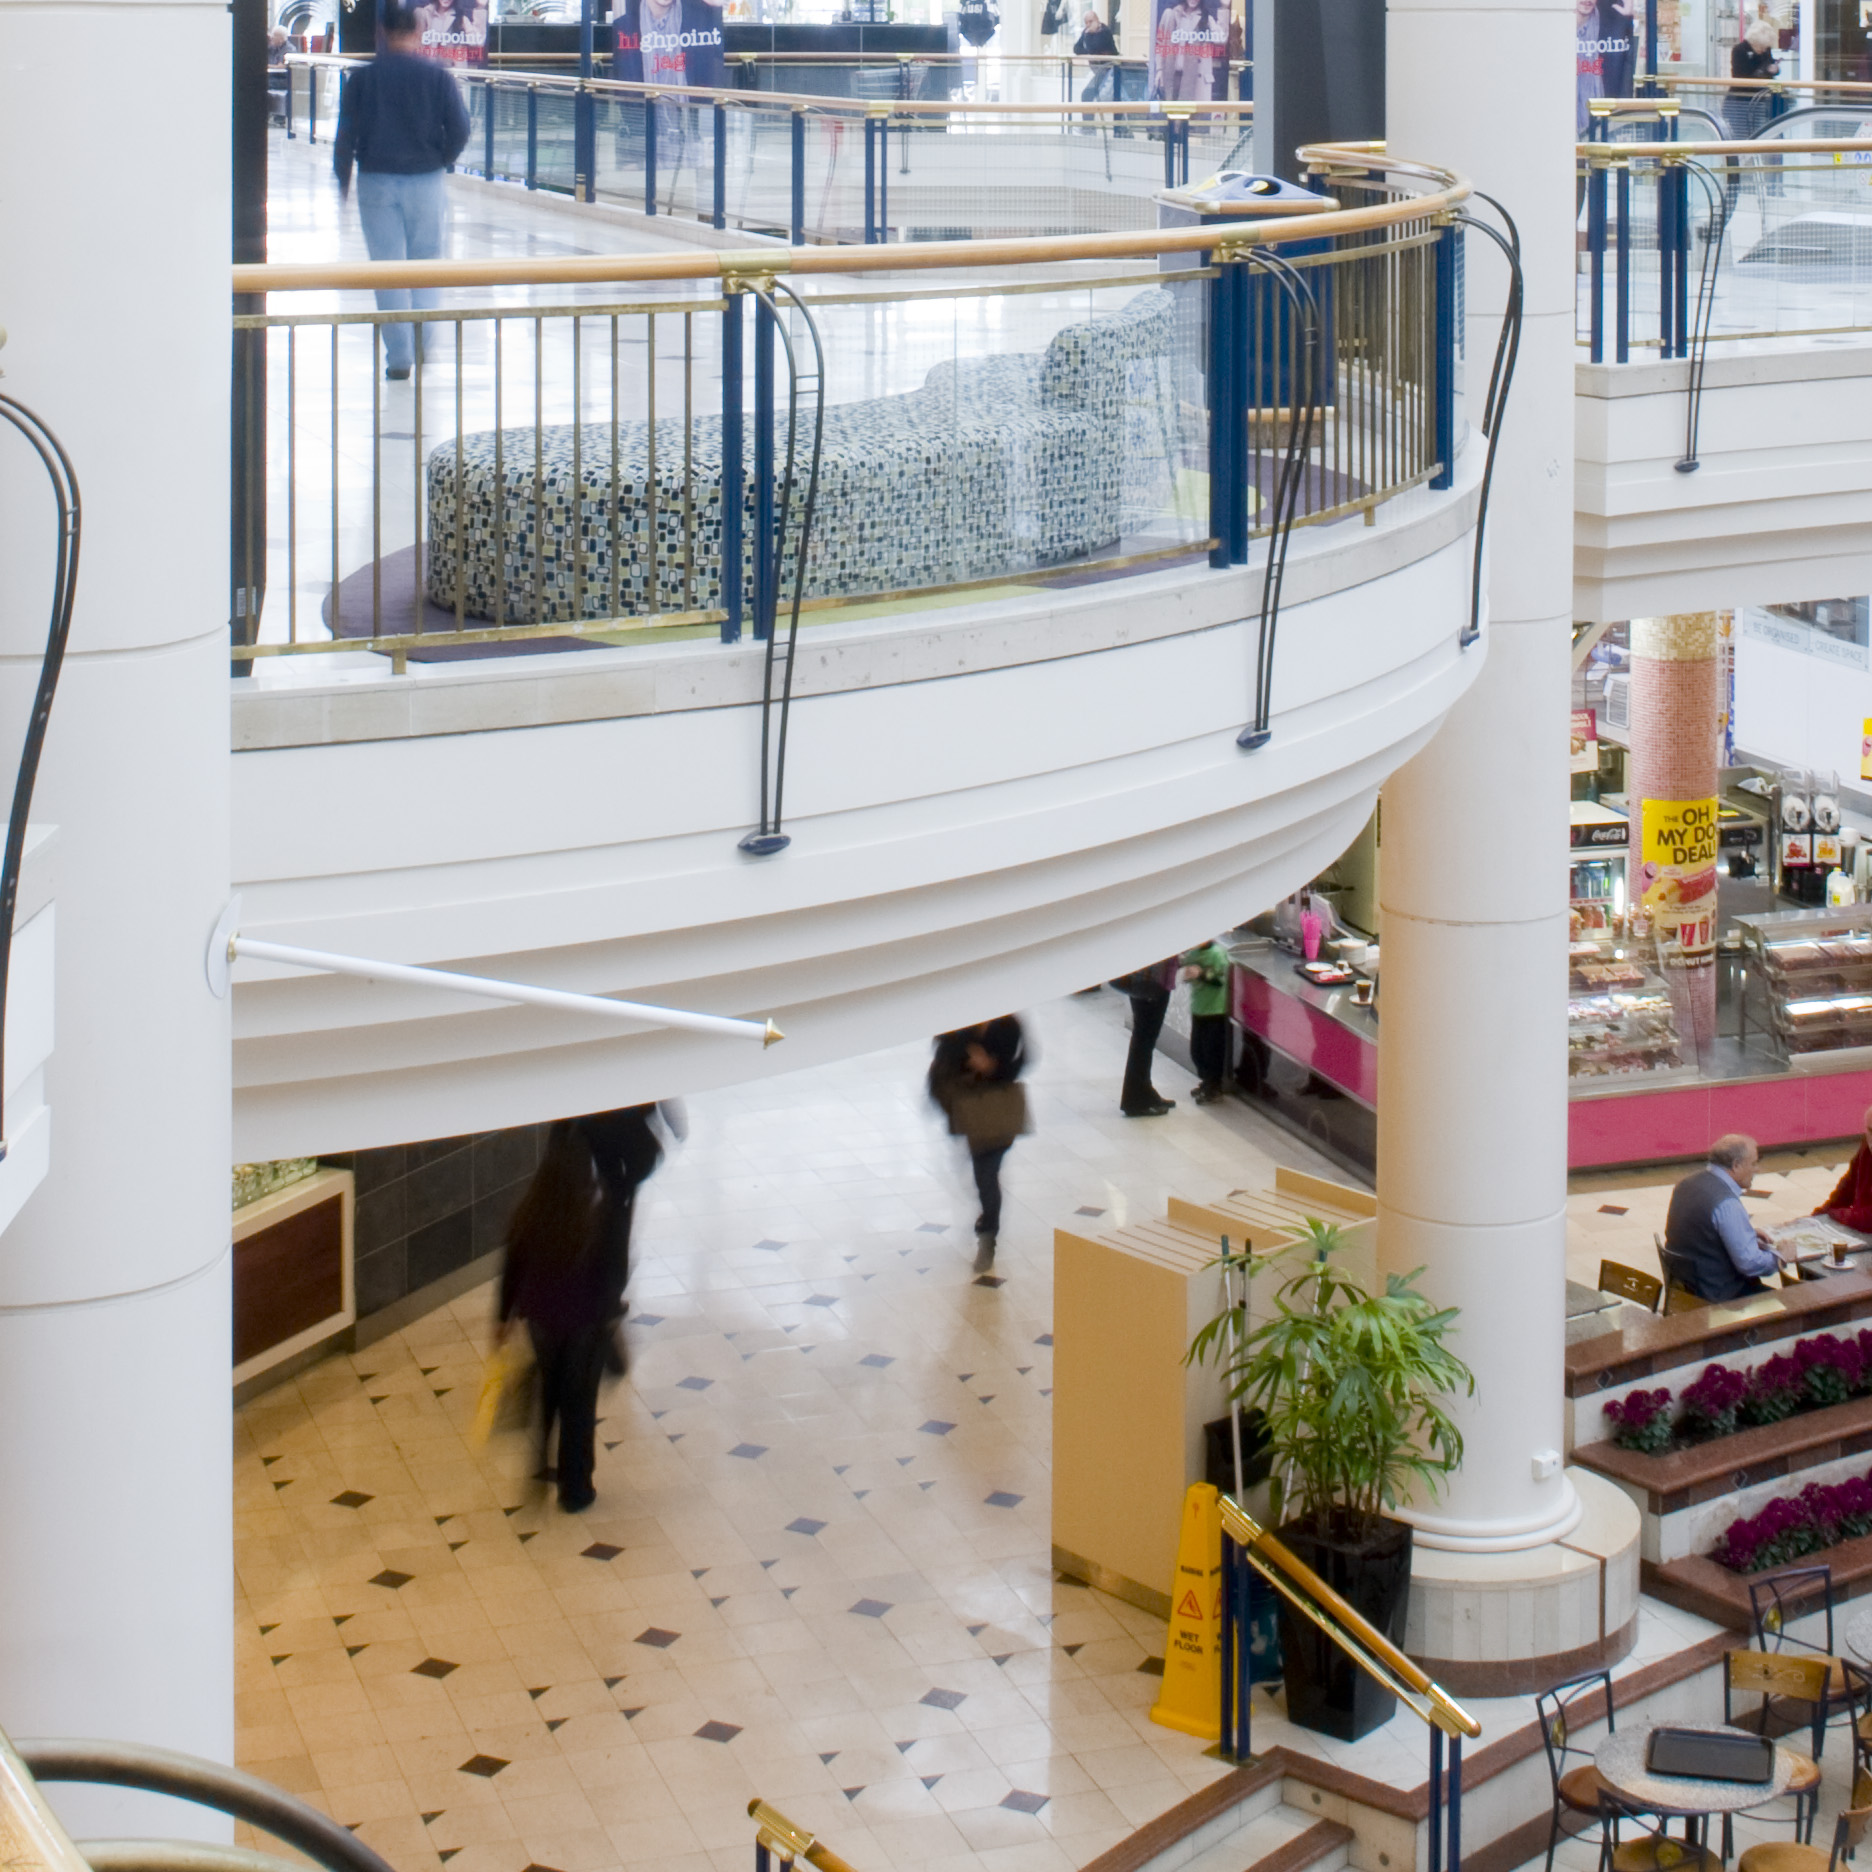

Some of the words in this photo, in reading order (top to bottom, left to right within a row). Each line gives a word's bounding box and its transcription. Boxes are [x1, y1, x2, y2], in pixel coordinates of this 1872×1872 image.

[618, 27, 722, 53] highpoint
[652, 52, 686, 74] jag
[1682, 806, 1710, 826] OH
[1657, 828, 1688, 846] MY
[1694, 823, 1716, 843] DO
[1179, 1629, 1200, 1643] WET
[1174, 1639, 1203, 1655] FLOOR
